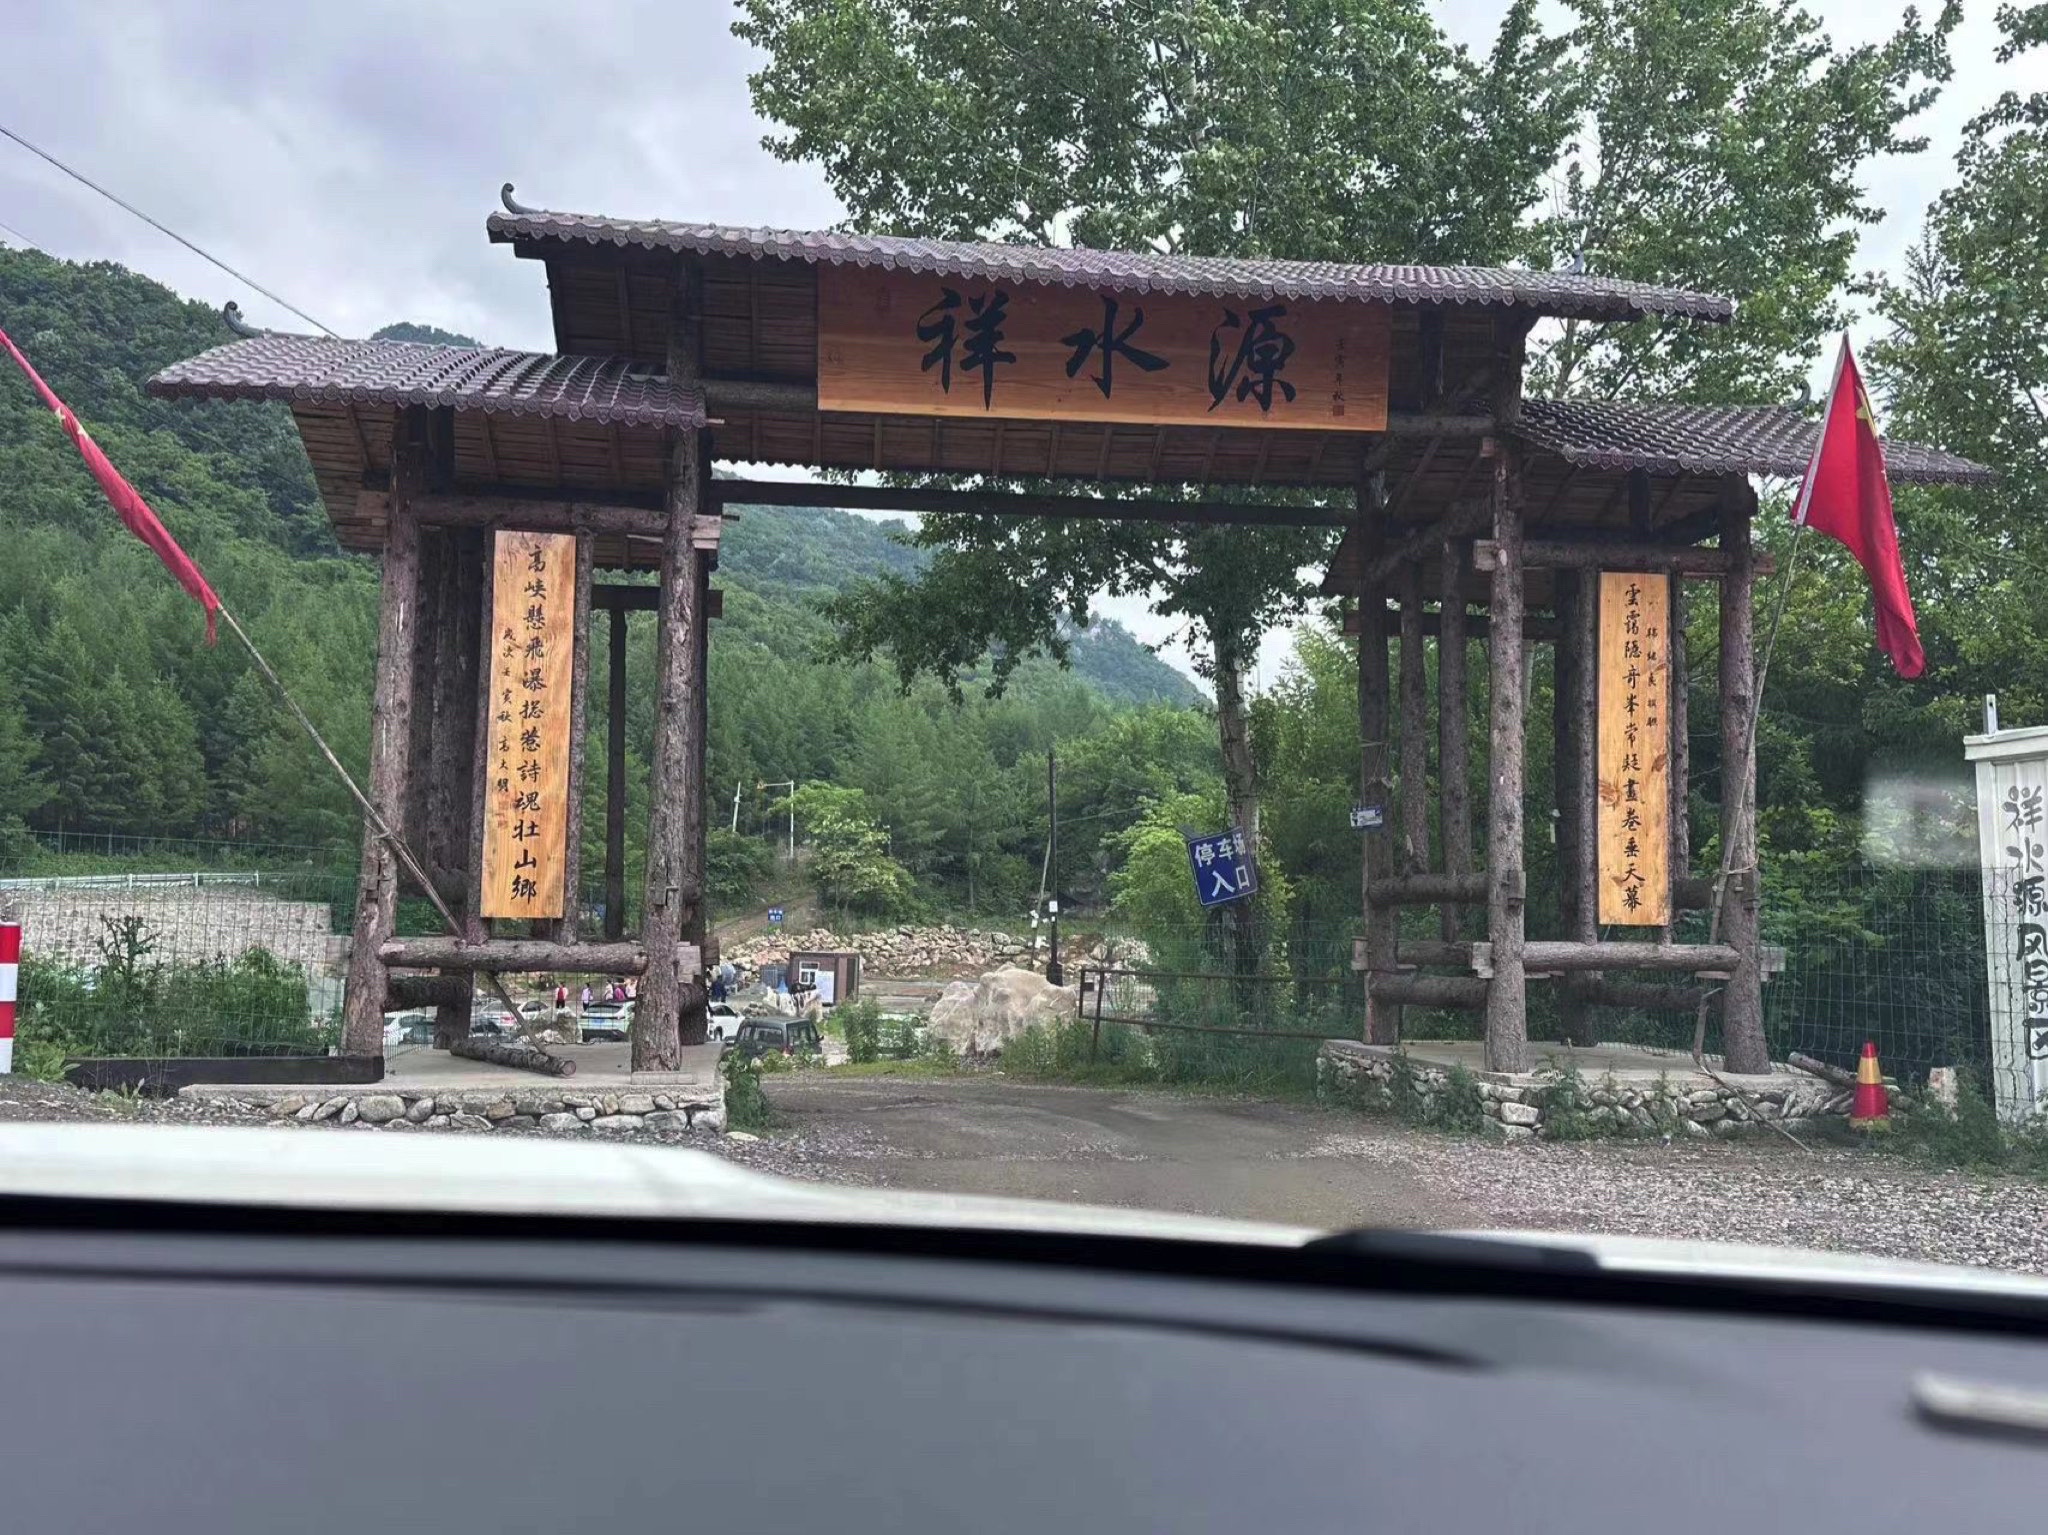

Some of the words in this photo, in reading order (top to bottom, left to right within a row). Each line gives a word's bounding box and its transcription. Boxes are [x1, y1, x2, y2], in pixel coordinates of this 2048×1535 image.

[916, 286, 1298, 413] 祥水源
[1194, 833, 1246, 868] 停车场
[1211, 865, 1250, 897] 入口
[2001, 785, 2048, 1060] 祥水源风景区
